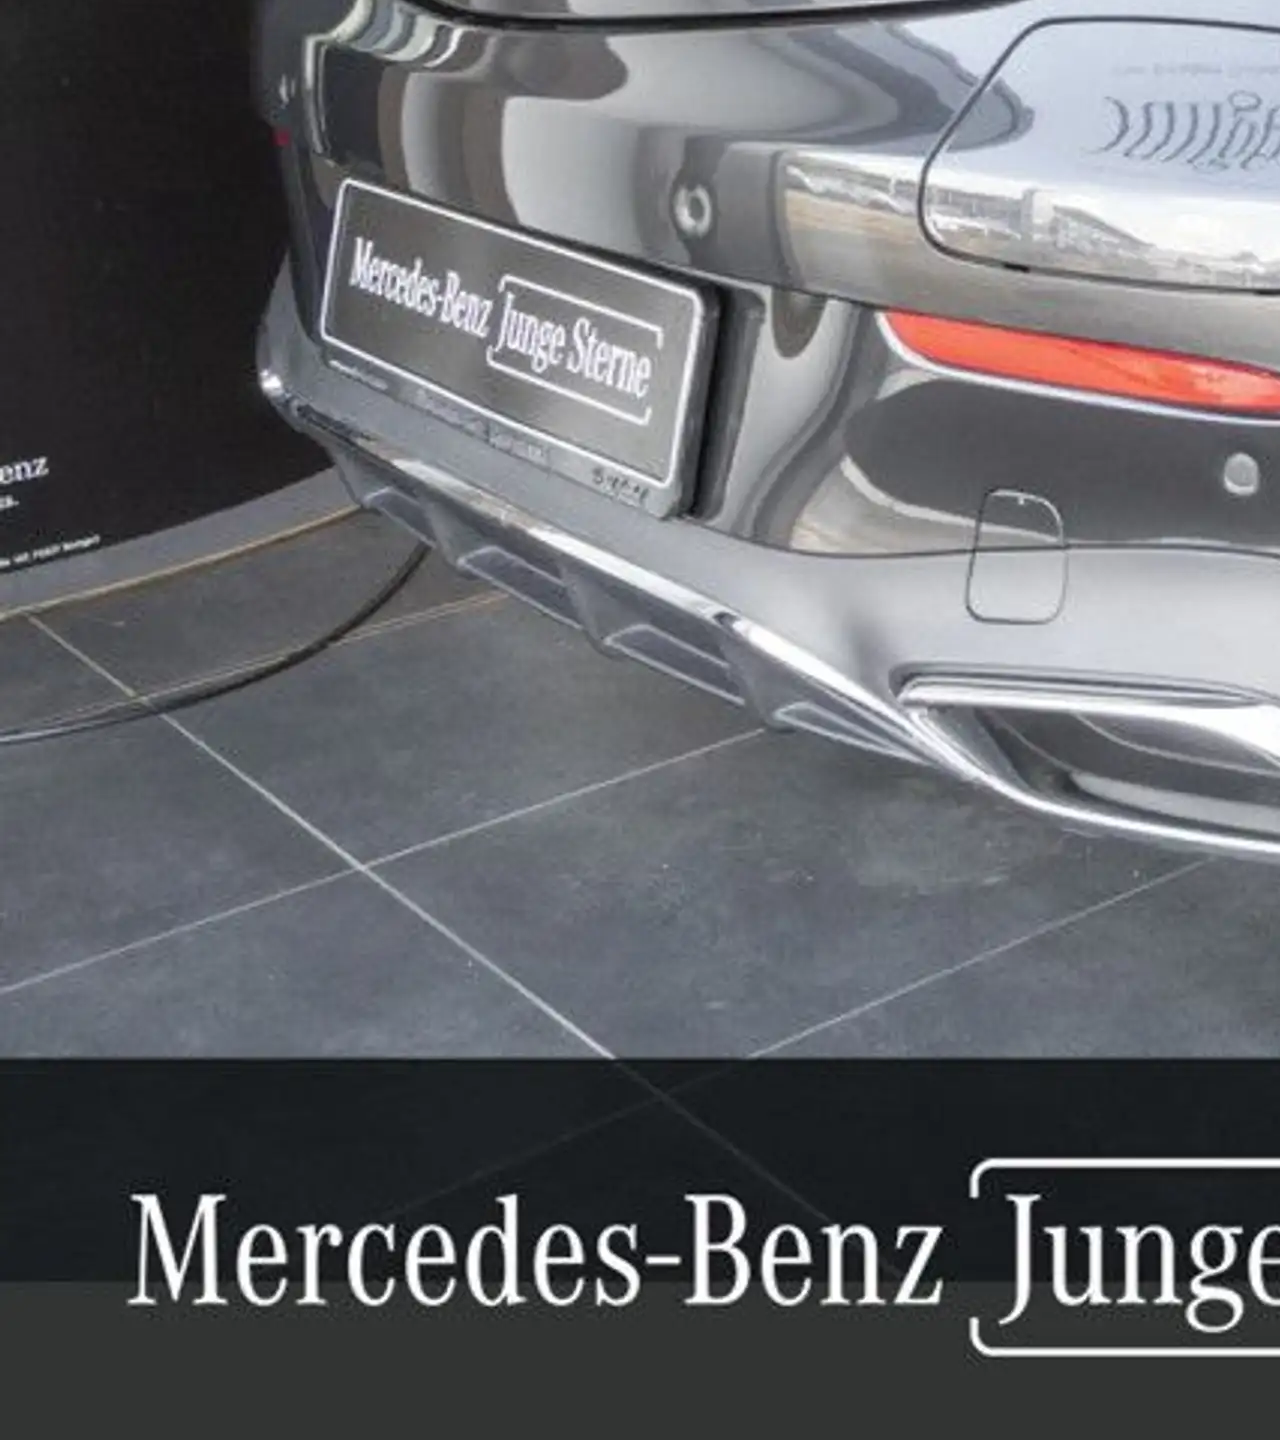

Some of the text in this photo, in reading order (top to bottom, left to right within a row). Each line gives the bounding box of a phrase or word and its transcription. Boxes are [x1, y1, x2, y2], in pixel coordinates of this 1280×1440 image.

[348, 236, 653, 400] Mercedes-Benz Junge Sterne
